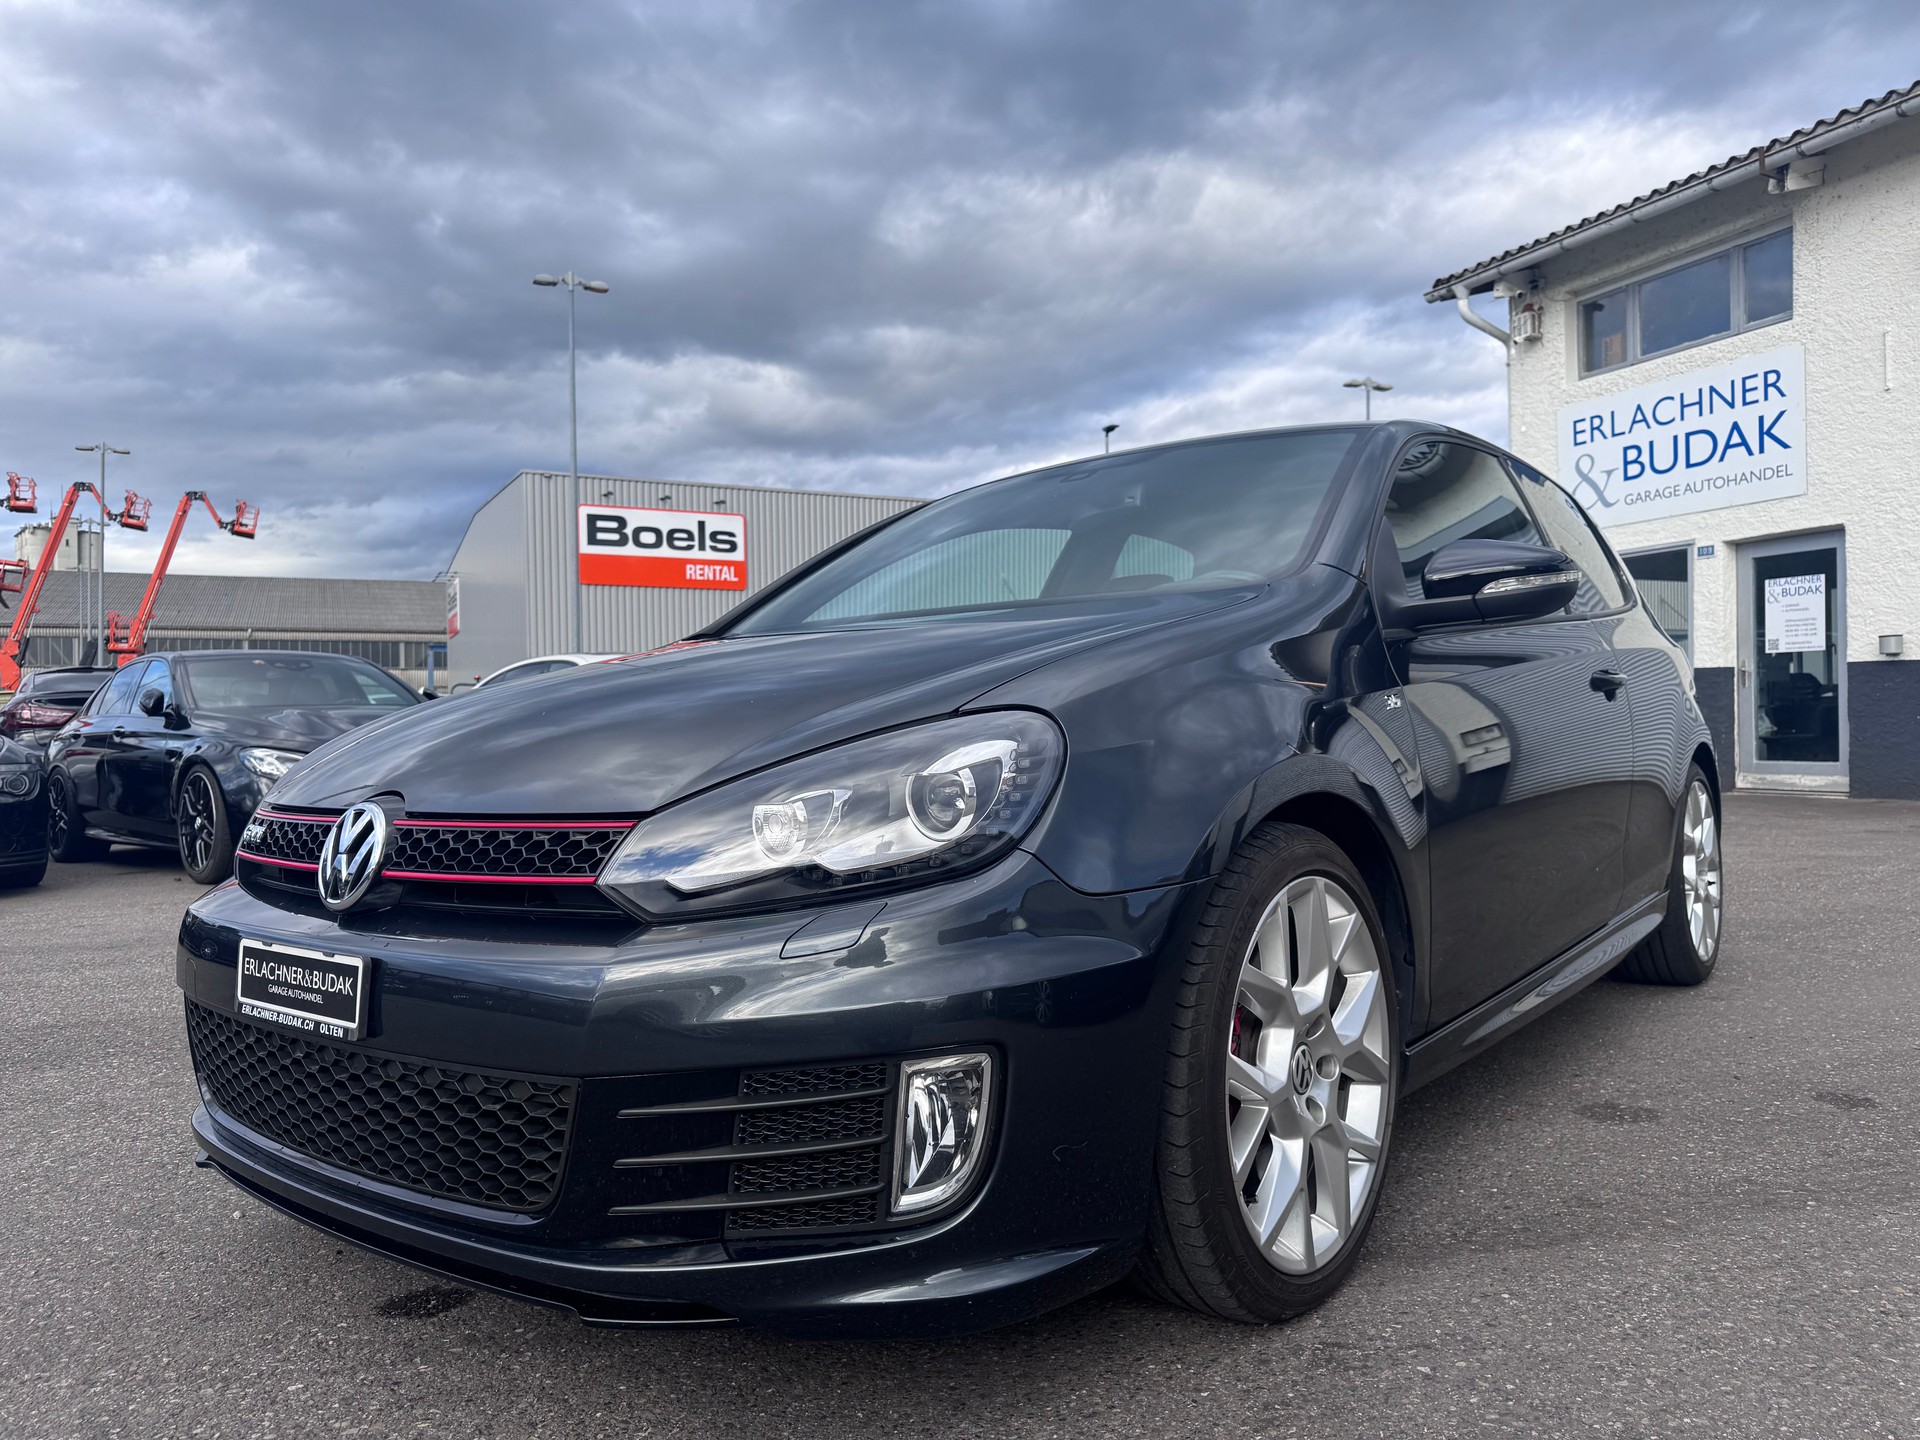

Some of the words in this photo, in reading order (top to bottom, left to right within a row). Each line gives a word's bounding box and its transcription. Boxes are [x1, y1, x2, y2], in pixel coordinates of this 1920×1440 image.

[1573, 369, 1787, 446] ERLACHNER
[1572, 453, 1619, 510] &
[1623, 409, 1792, 482] BUDAK
[1624, 484, 1681, 505] GARAGE
[1683, 463, 1793, 495] AUTOHANDEL
[587, 513, 738, 553] Boels
[685, 564, 739, 582] RENTAL
[1768, 575, 1822, 588] ERLACHNER
[1781, 584, 1823, 598] BUDAK
[244, 957, 354, 997] ERLACHNER&BUDAK
[267, 983, 288, 997] GARAGE
[288, 988, 324, 1004] AUTOHANDEL
[241, 1004, 315, 1031] ERLACHNER-BUDAK.CH
[319, 1023, 344, 1038] OLTEN
